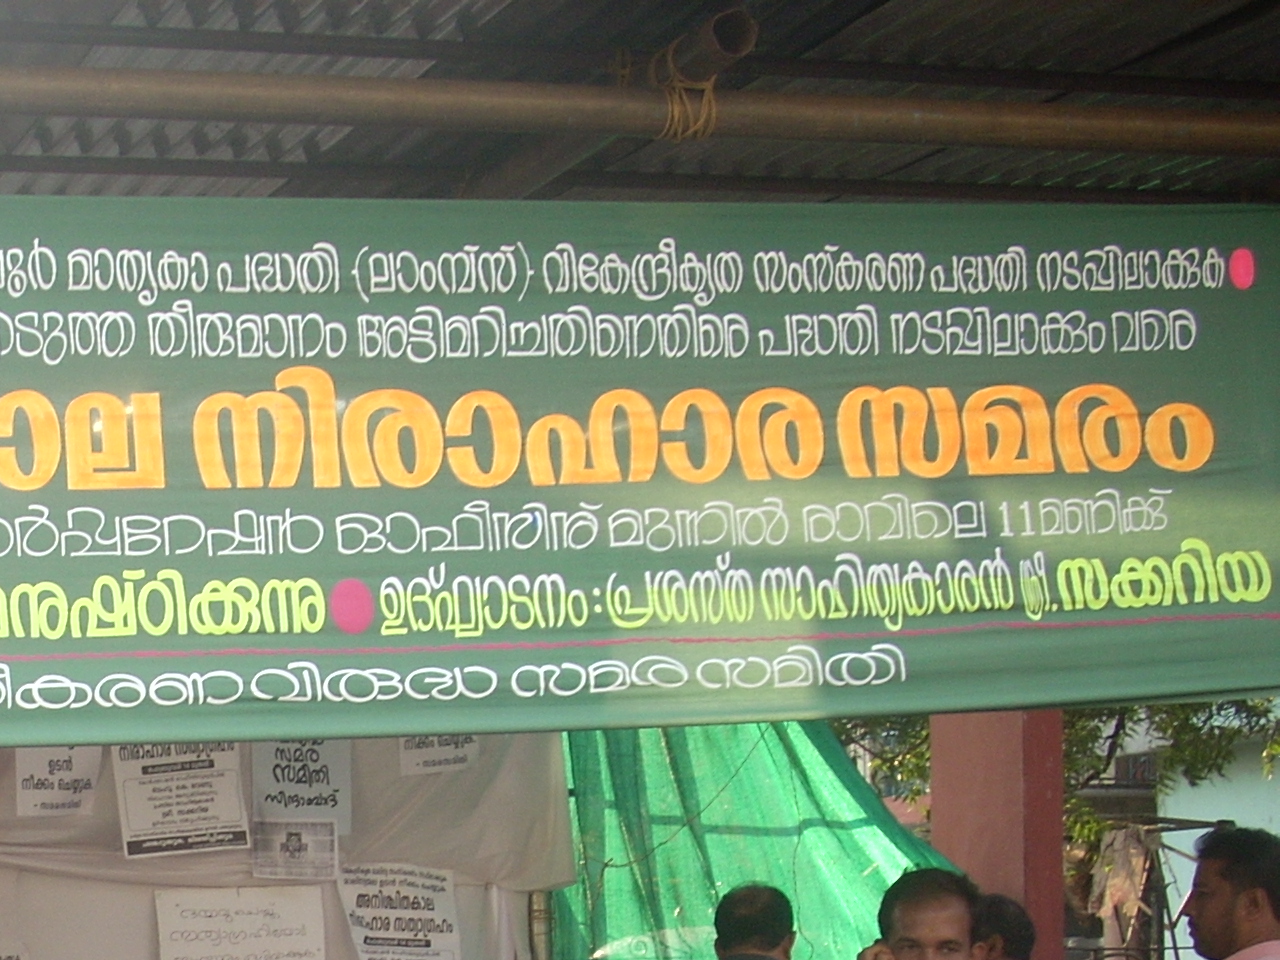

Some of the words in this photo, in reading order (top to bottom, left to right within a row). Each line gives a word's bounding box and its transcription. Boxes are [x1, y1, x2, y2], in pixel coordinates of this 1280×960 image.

[67, 248, 209, 307] മാതൃകാ
[217, 242, 341, 295] പദ്ധതി
[543, 238, 744, 307] വികേന്ദ്രീകൃത
[930, 246, 1027, 293] പദ്ധതി
[1036, 245, 1226, 293] നടപ്പിലാക്കുക
[147, 300, 347, 358] തീരുമാനം
[358, 304, 750, 363] അട്ടിമറിച്ചതിനെതിരെ
[759, 304, 879, 358] പദ്ധതി
[890, 306, 1106, 358] നടപ്പിലാക്കും
[1111, 308, 1197, 353] വരെ
[192, 365, 825, 489] നിരാഹാര
[836, 382, 1214, 481] സമരം
[607, 497, 791, 552] മുന്നിൽ
[802, 493, 987, 542] രാവിലെ
[758, 547, 1015, 630] സാഹിത്യകാരൻ
[510, 656, 688, 697] സമര
[695, 643, 908, 691] സമിതി
